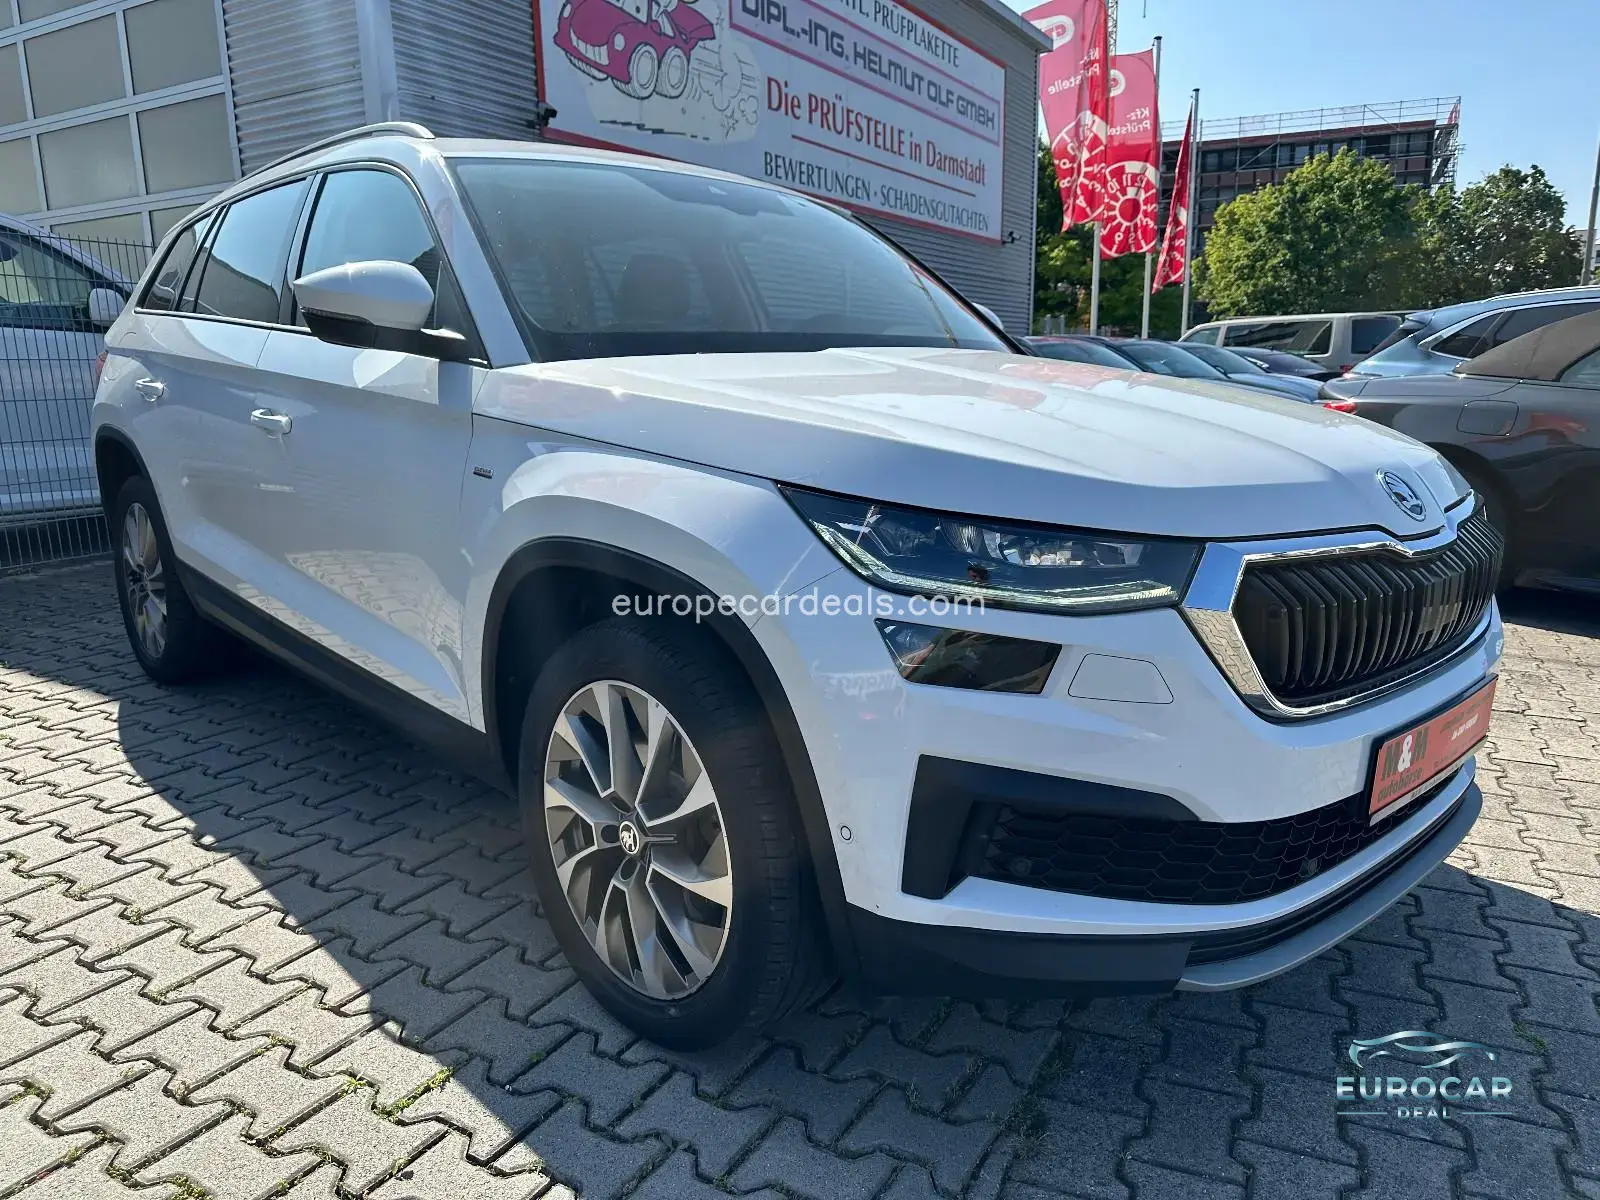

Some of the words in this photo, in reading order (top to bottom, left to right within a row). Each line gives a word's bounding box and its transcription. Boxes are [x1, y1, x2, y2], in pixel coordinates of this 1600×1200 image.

[853, 41, 924, 96] HELMUT
[873, 0, 959, 68] PRÜFPLAKETTE
[766, 76, 800, 120] Die
[808, 92, 905, 158] PRÜFSTELLE
[909, 131, 922, 164] in
[926, 139, 986, 187] Darmstadt
[764, 151, 871, 201] BEWERTUNGEN
[880, 184, 989, 232] SCHADENSGUTACHTEN
